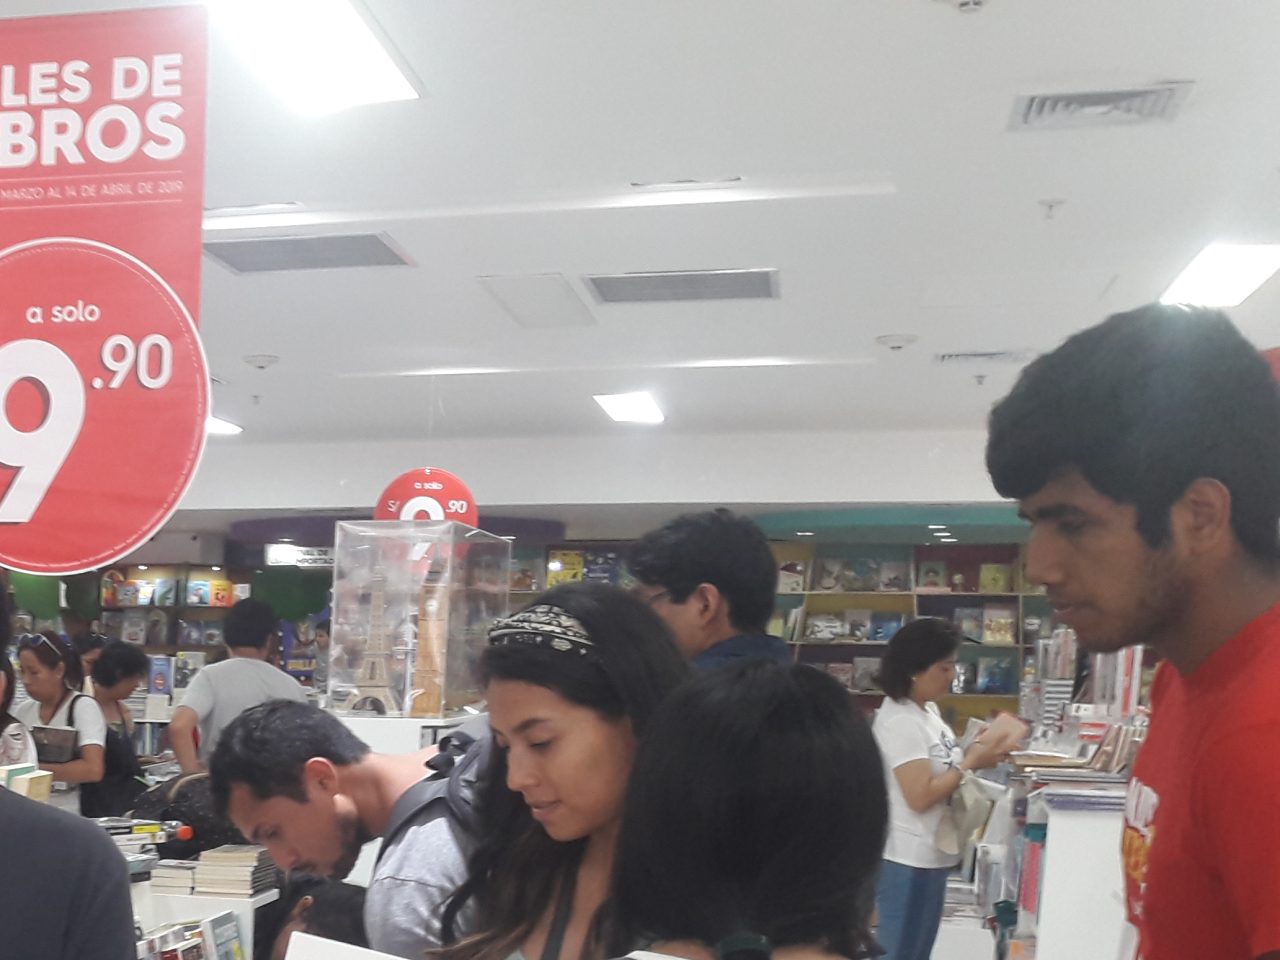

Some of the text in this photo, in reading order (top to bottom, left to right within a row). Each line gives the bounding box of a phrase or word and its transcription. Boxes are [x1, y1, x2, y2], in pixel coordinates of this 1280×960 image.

[111, 53, 184, 101] DE
[0, 186, 45, 201] MARZO
[80, 184, 97, 198] DE
[137, 181, 154, 195] DE
[25, 299, 102, 324] a solo
